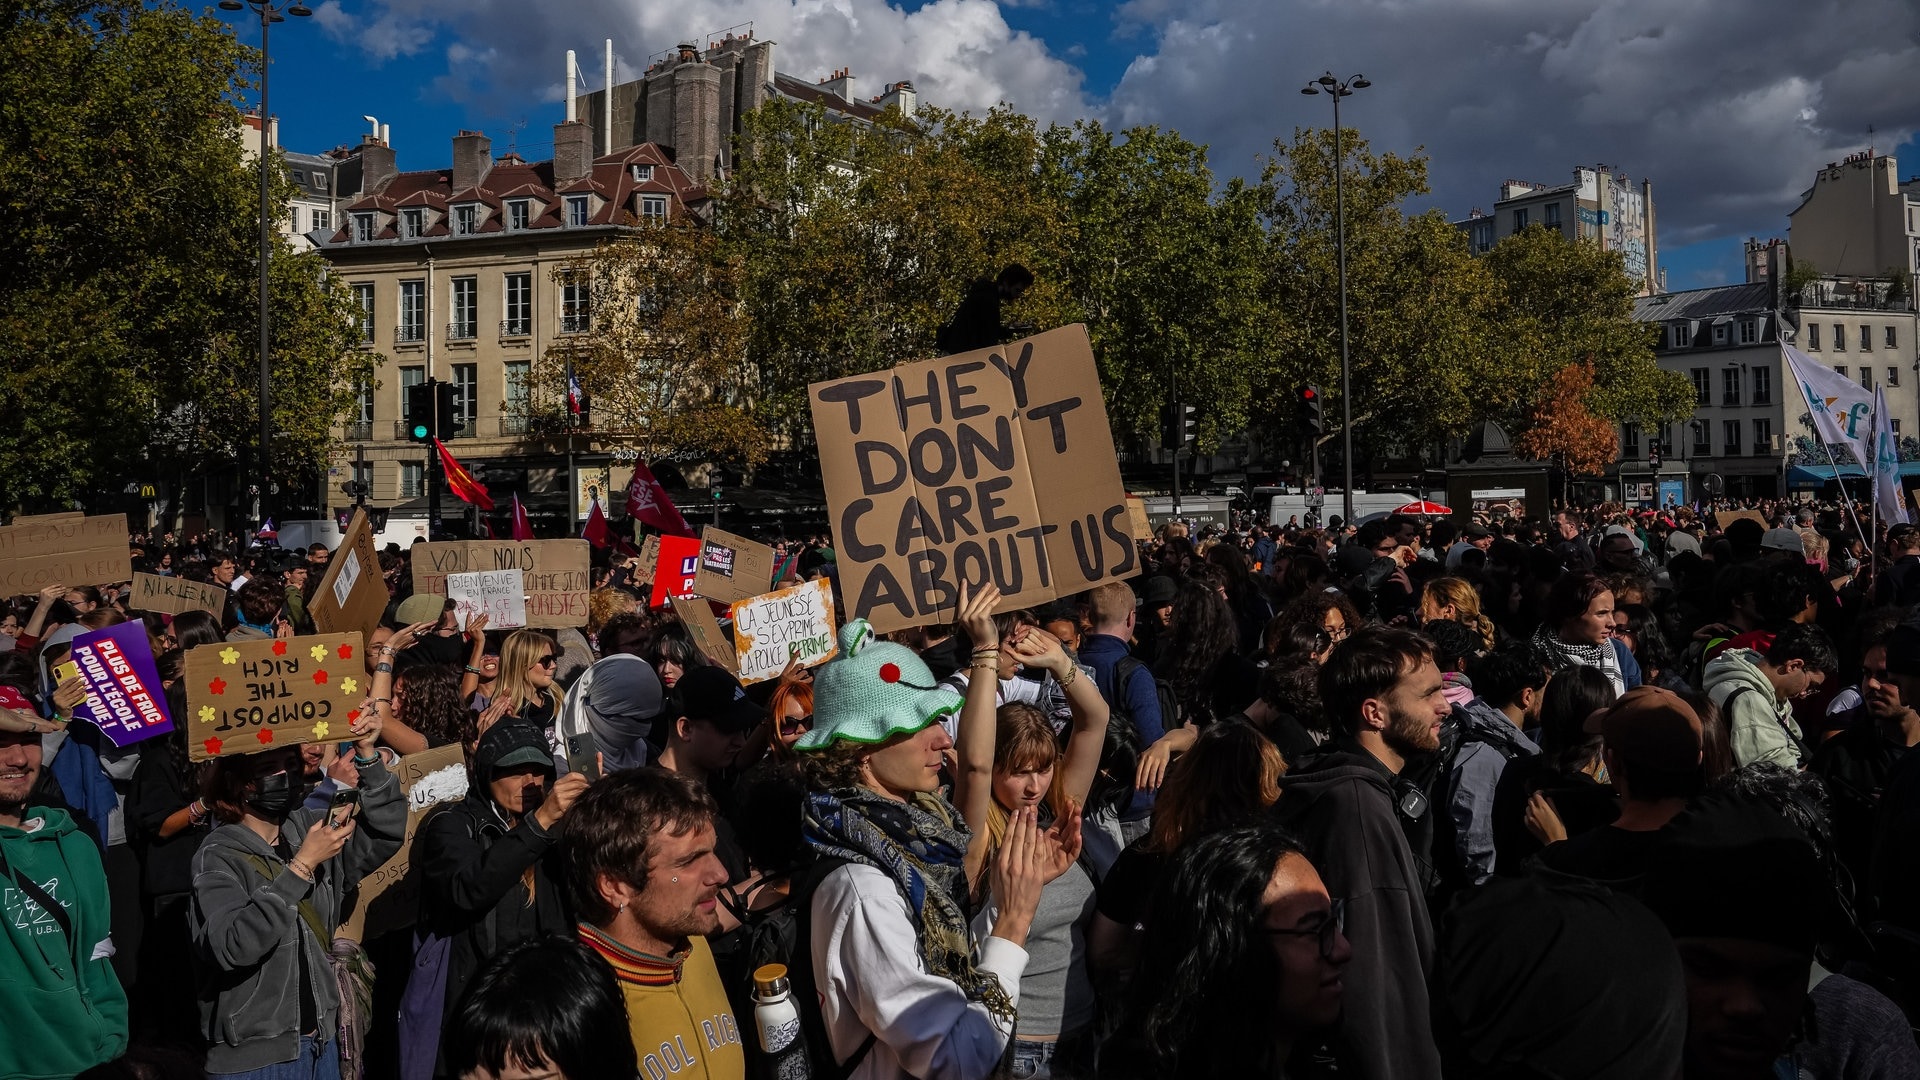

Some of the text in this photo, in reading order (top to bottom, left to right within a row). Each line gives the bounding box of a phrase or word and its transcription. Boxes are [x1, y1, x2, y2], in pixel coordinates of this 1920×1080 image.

[818, 343, 1033, 434] THEY
[855, 397, 1081, 495] DON'T
[841, 476, 1020, 563] CARE
[431, 547, 534, 572] VOUS NOUS
[855, 505, 1134, 619] ABOUT US
[456, 600, 479, 614] PAS
[495, 598, 511, 610] CE
[737, 591, 814, 632] LA JEUNESSE
[757, 616, 817, 645] S'EXPRIME
[740, 651, 754, 677] LA
[753, 645, 785, 674] POLICE
[74, 646, 143, 732] POUR L'ÉCOLE
[97, 640, 162, 723] PLUS DE FRIC
[246, 680, 294, 702] THE
[215, 700, 332, 732] COMPOST
[415, 788, 437, 804] US
